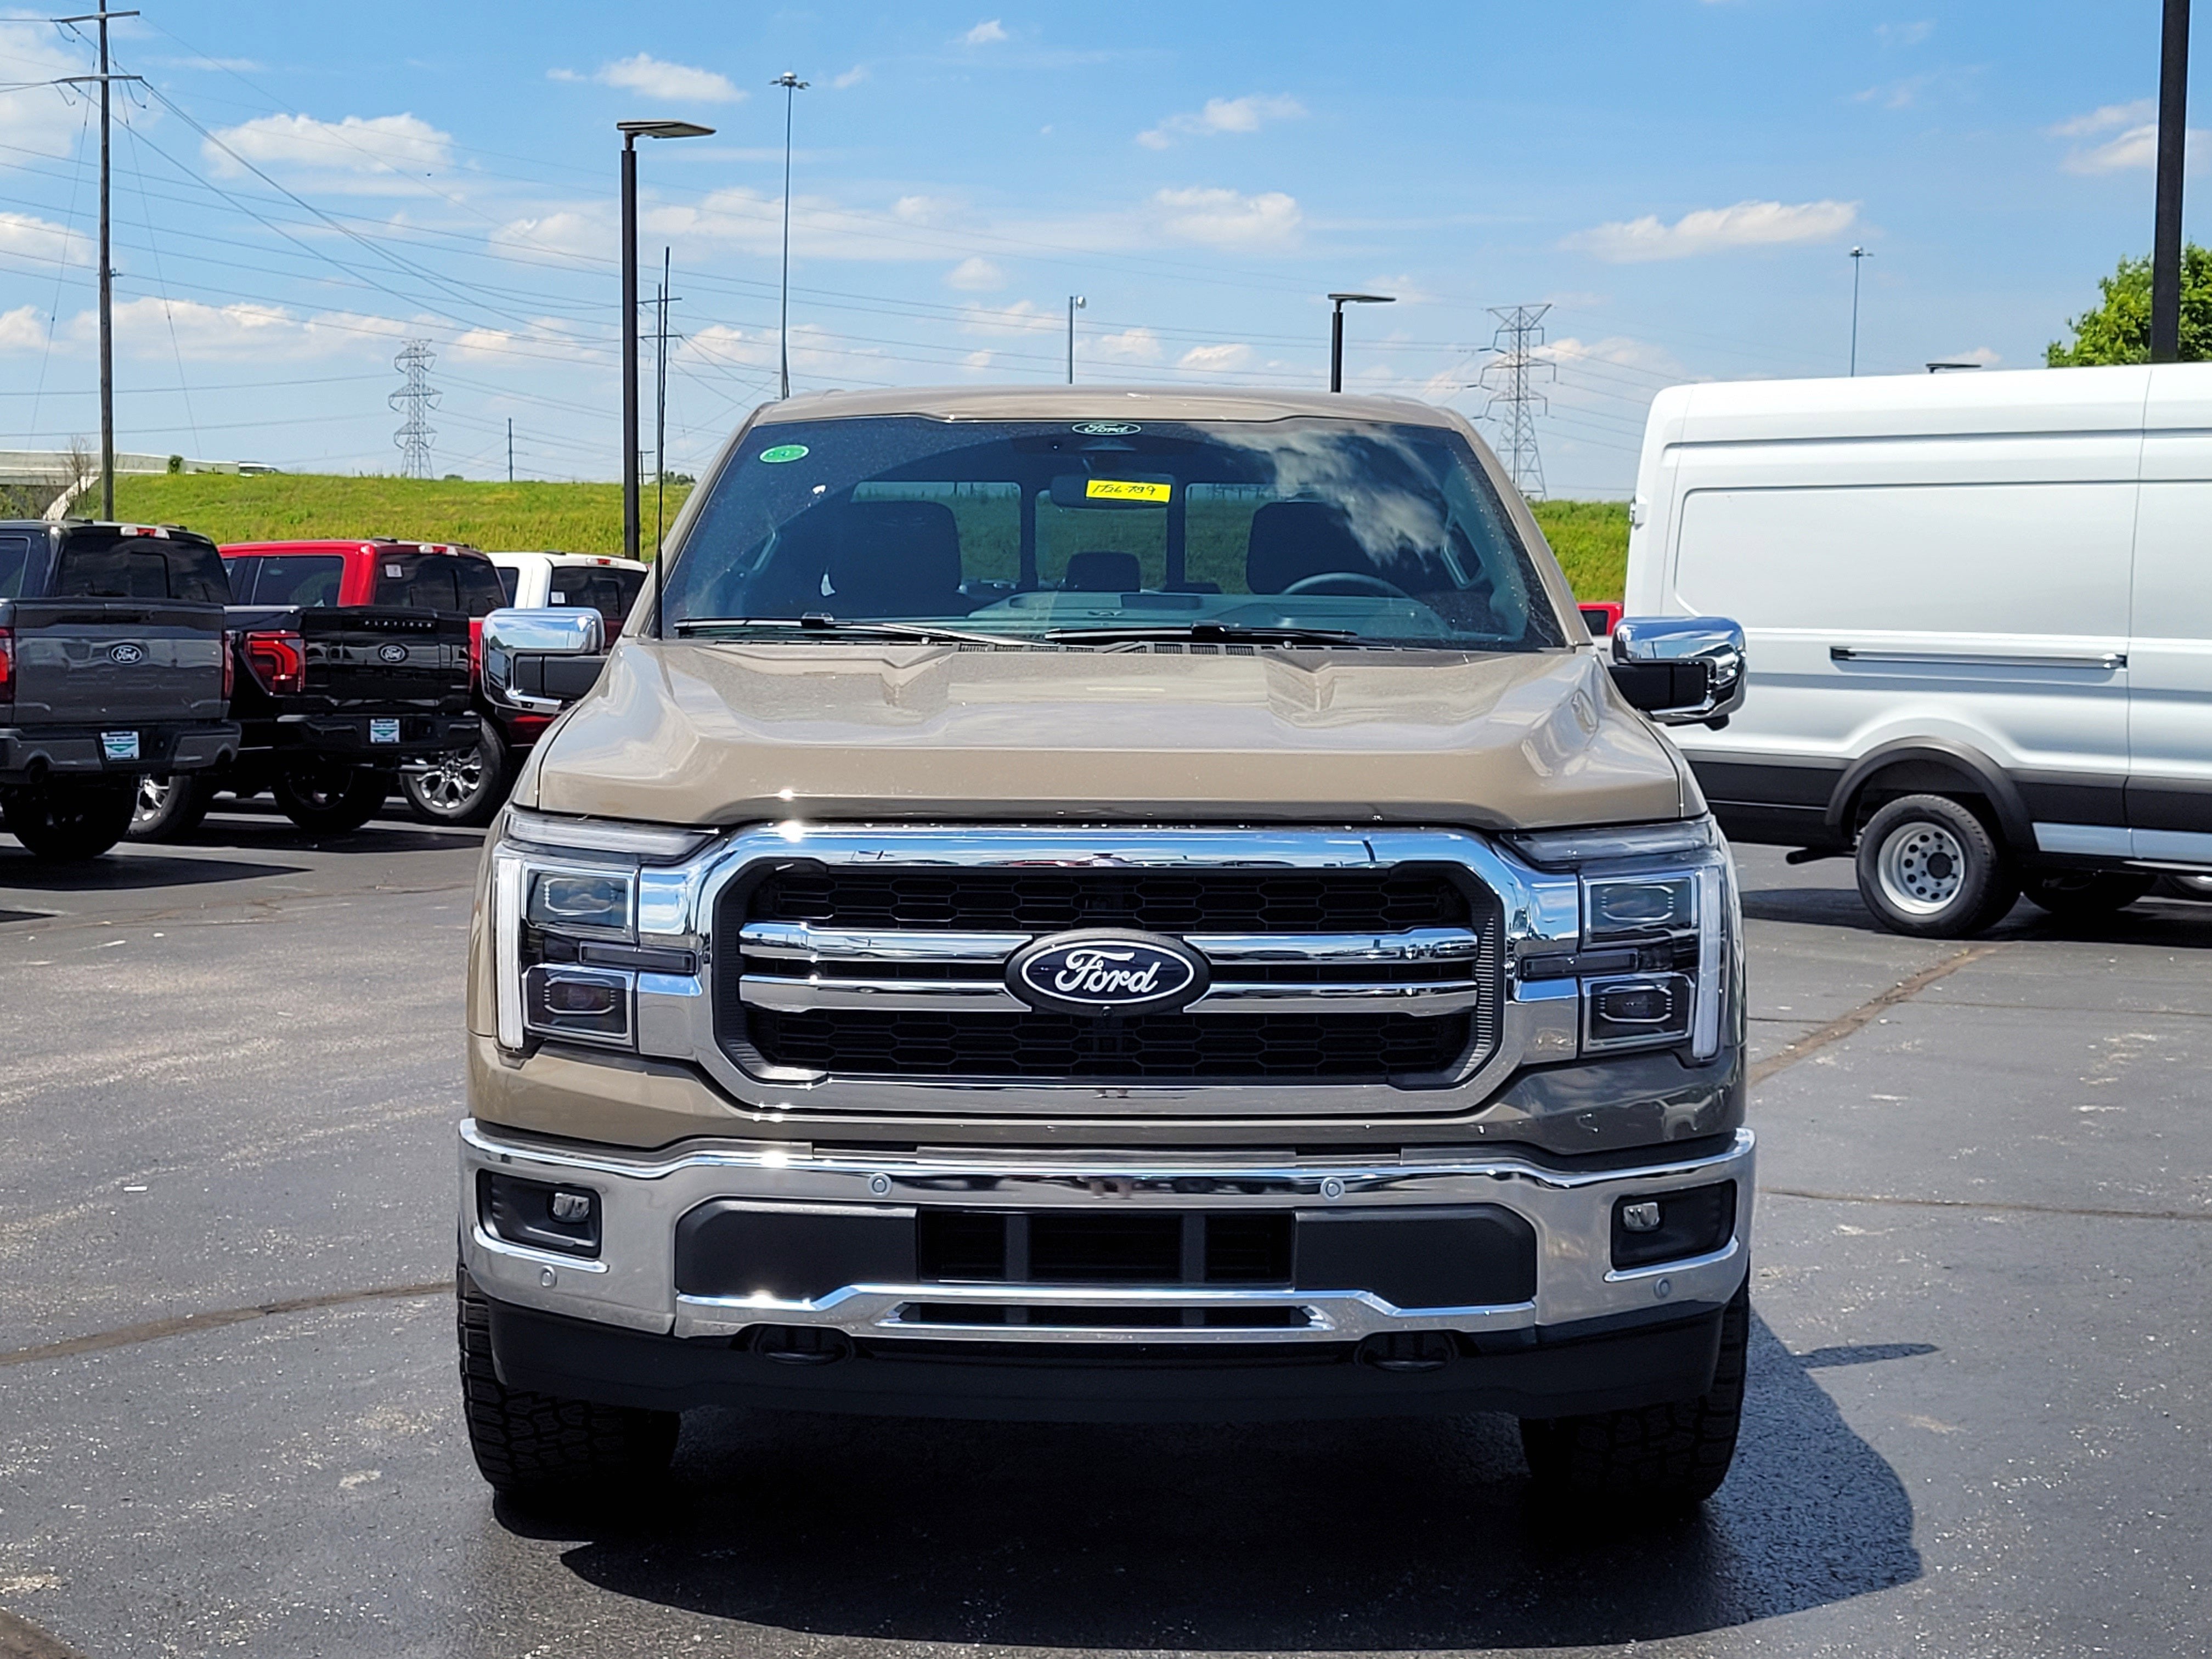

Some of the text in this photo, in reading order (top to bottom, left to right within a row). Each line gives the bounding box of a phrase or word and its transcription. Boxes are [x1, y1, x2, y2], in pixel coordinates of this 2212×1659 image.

[1084, 424, 1129, 433] Ford
[116, 647, 137, 661] Ford
[1055, 949, 1161, 993] Ford
